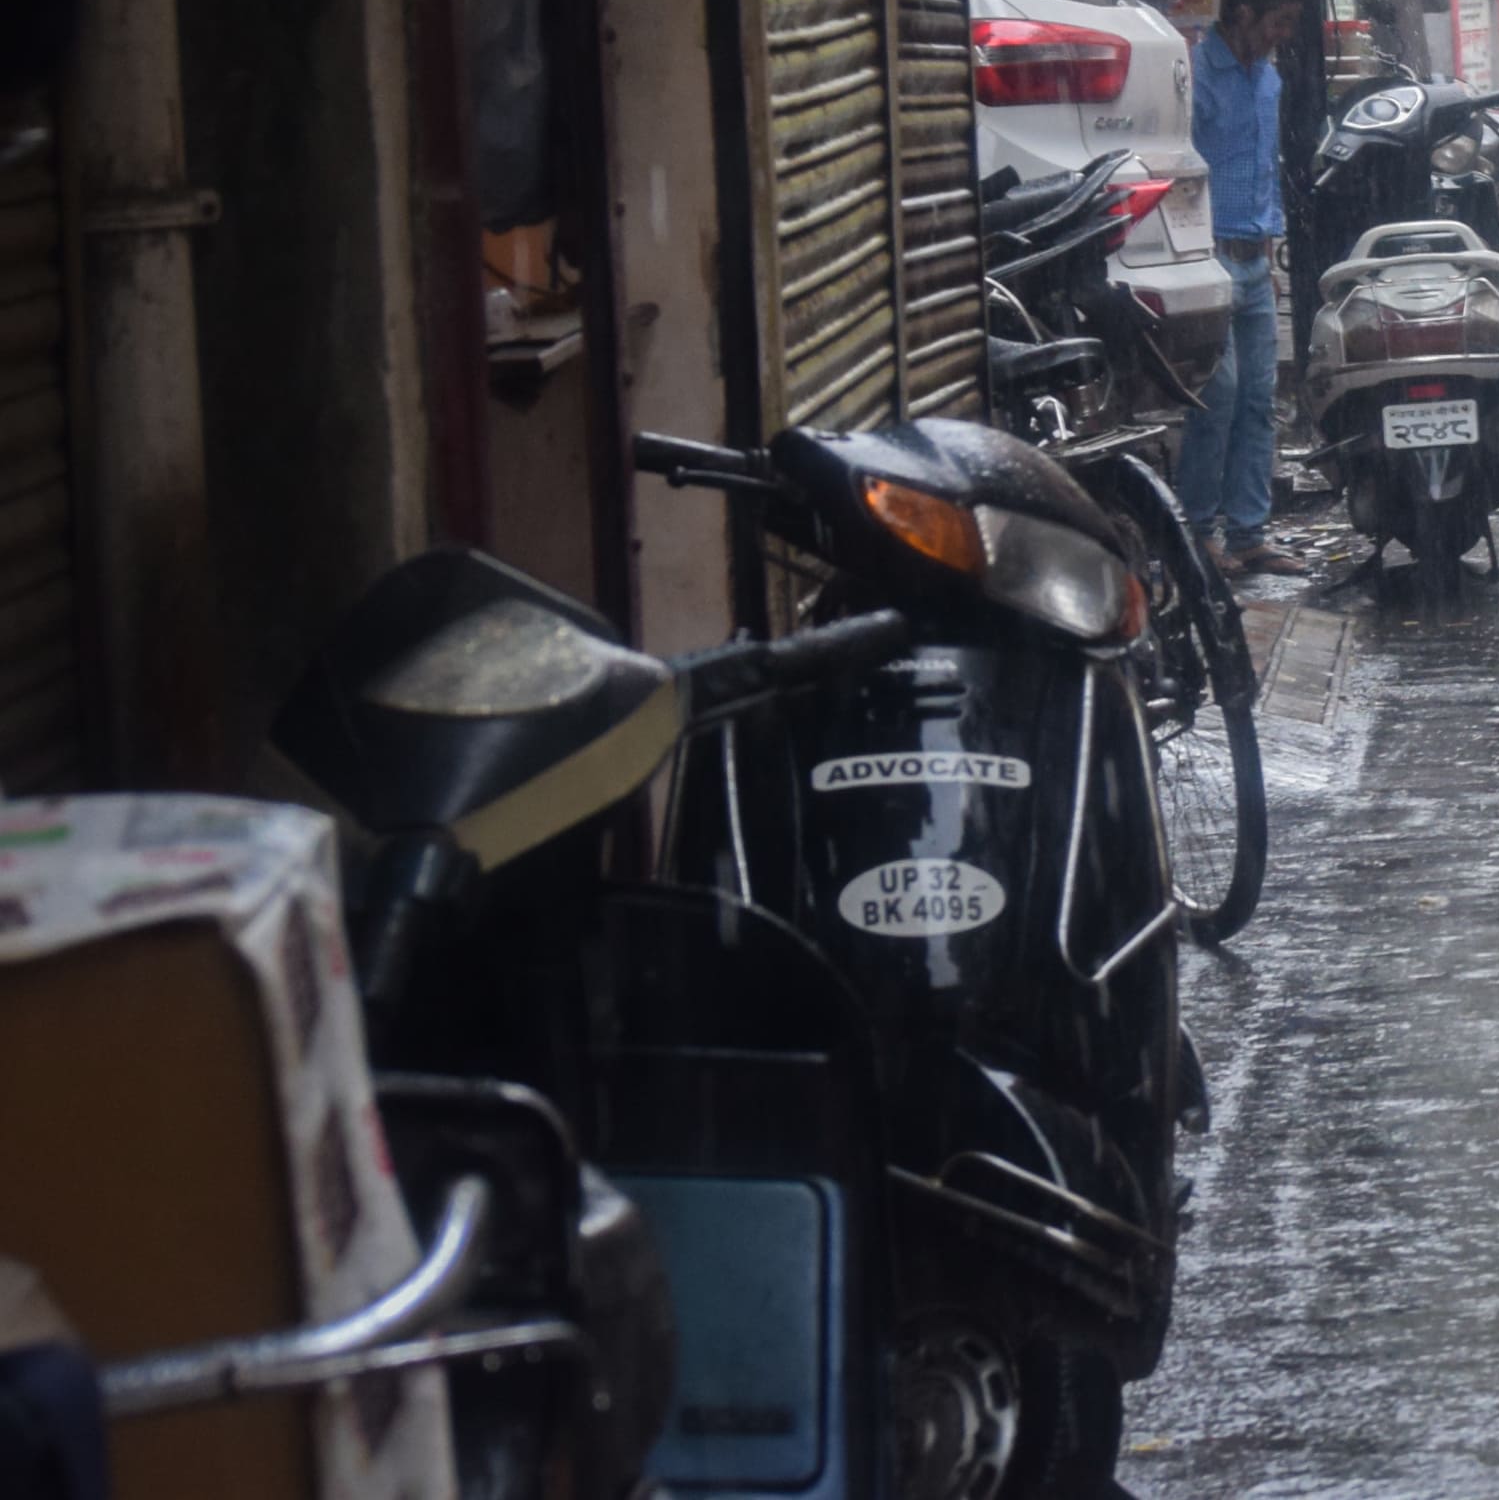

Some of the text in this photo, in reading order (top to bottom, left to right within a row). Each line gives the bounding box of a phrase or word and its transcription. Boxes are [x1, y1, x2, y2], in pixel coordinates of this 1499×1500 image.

[1391, 419, 1471, 444] २८४८
[827, 758, 1018, 784] ADVOCATE
[879, 866, 961, 893] UP 32
[862, 896, 983, 927] BK 4095
